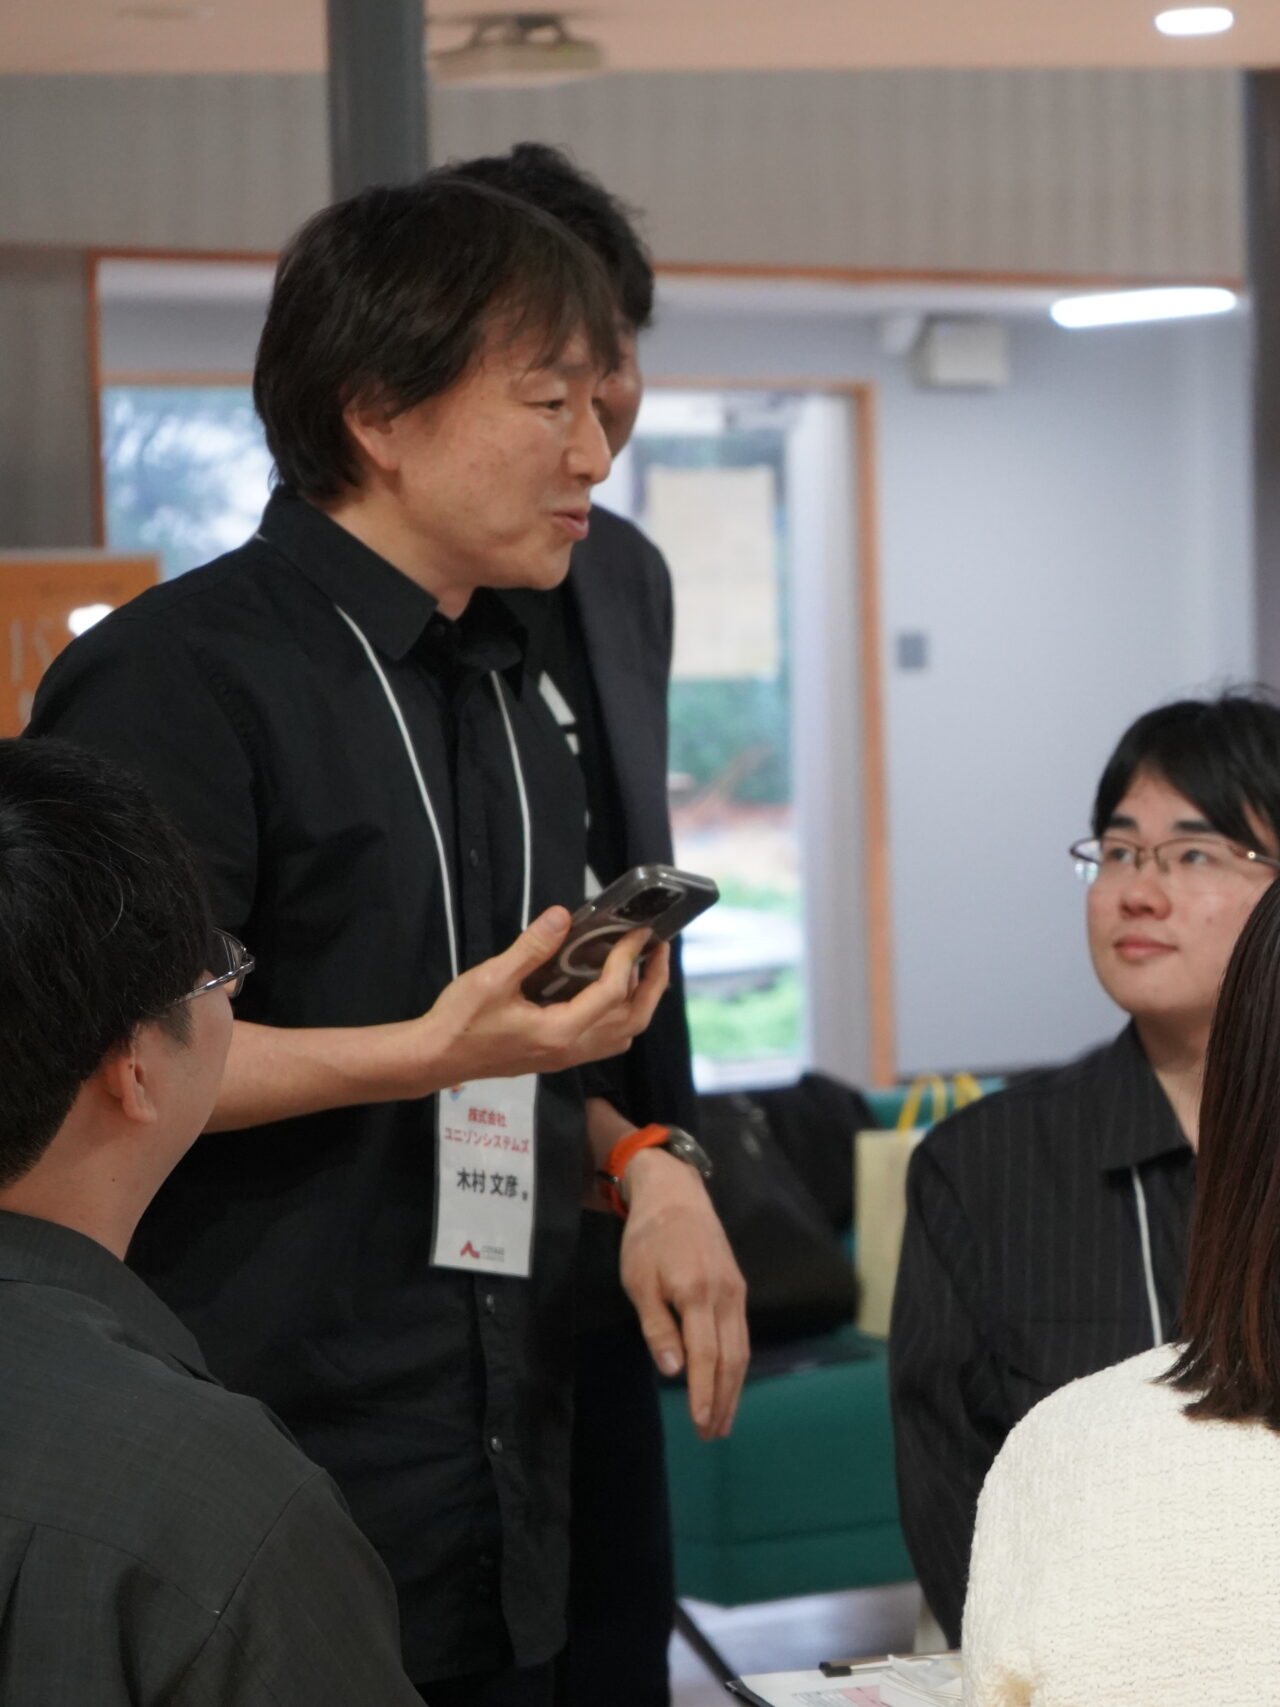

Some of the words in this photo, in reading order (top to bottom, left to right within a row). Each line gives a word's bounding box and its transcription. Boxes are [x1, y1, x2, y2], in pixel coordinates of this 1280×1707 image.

[468, 1108, 507, 1127] 株式会社
[445, 1128, 529, 1152] ユニゾンシステムズ
[457, 1168, 485, 1193] 木村
[490, 1173, 518, 1197] 文彦
